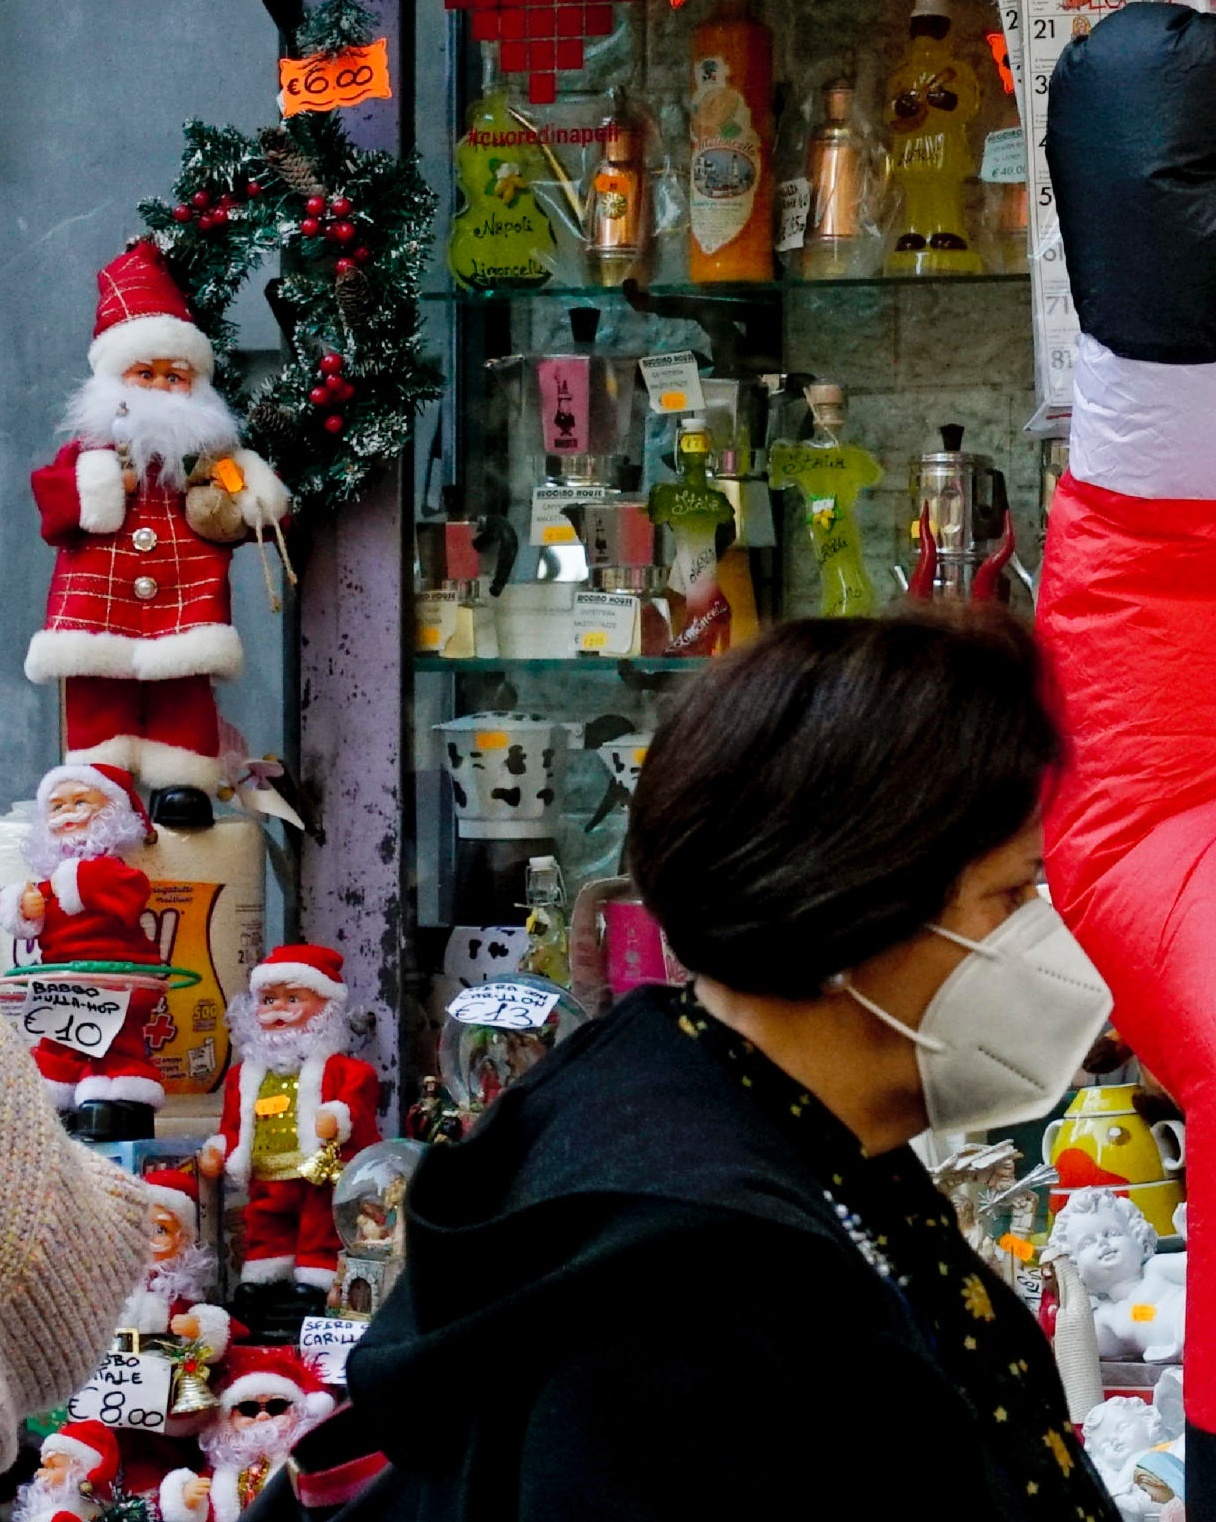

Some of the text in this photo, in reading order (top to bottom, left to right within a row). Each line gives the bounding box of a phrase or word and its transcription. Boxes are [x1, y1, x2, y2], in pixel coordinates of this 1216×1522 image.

[1034, 19, 1055, 38] 21
[1046, 296, 1070, 315] 71
[1051, 350, 1071, 370] 81
[32, 981, 100, 1008] BABBO
